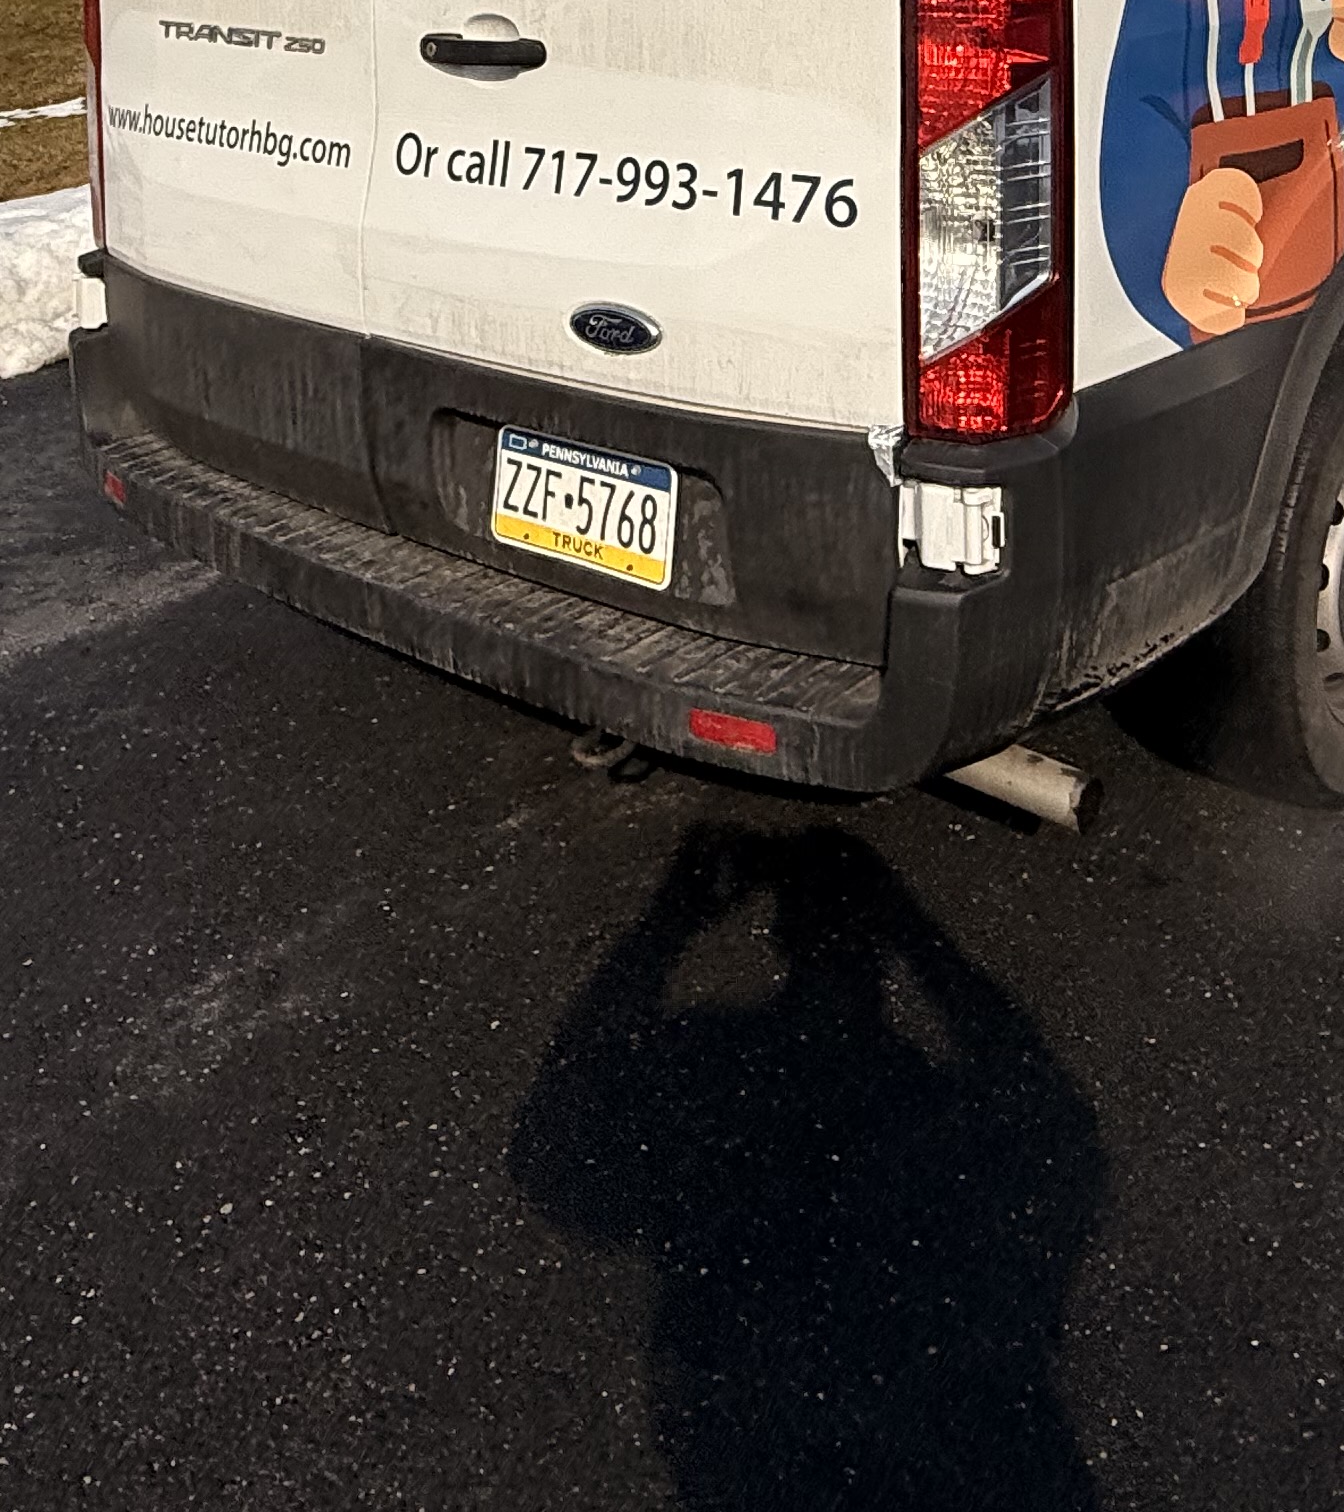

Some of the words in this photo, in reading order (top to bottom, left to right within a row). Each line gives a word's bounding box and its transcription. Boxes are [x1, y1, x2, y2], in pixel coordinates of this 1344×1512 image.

[159, 19, 282, 50] TRANSIT
[284, 36, 326, 55] 250
[108, 103, 351, 169] www.housetutorhbg.com
[396, 132, 439, 178] Or
[447, 139, 511, 187] call
[522, 145, 858, 228] 717-993-1476
[584, 313, 635, 346] Ford
[541, 443, 630, 479] PENNSYLVANIA
[552, 531, 604, 561] TRUCK
